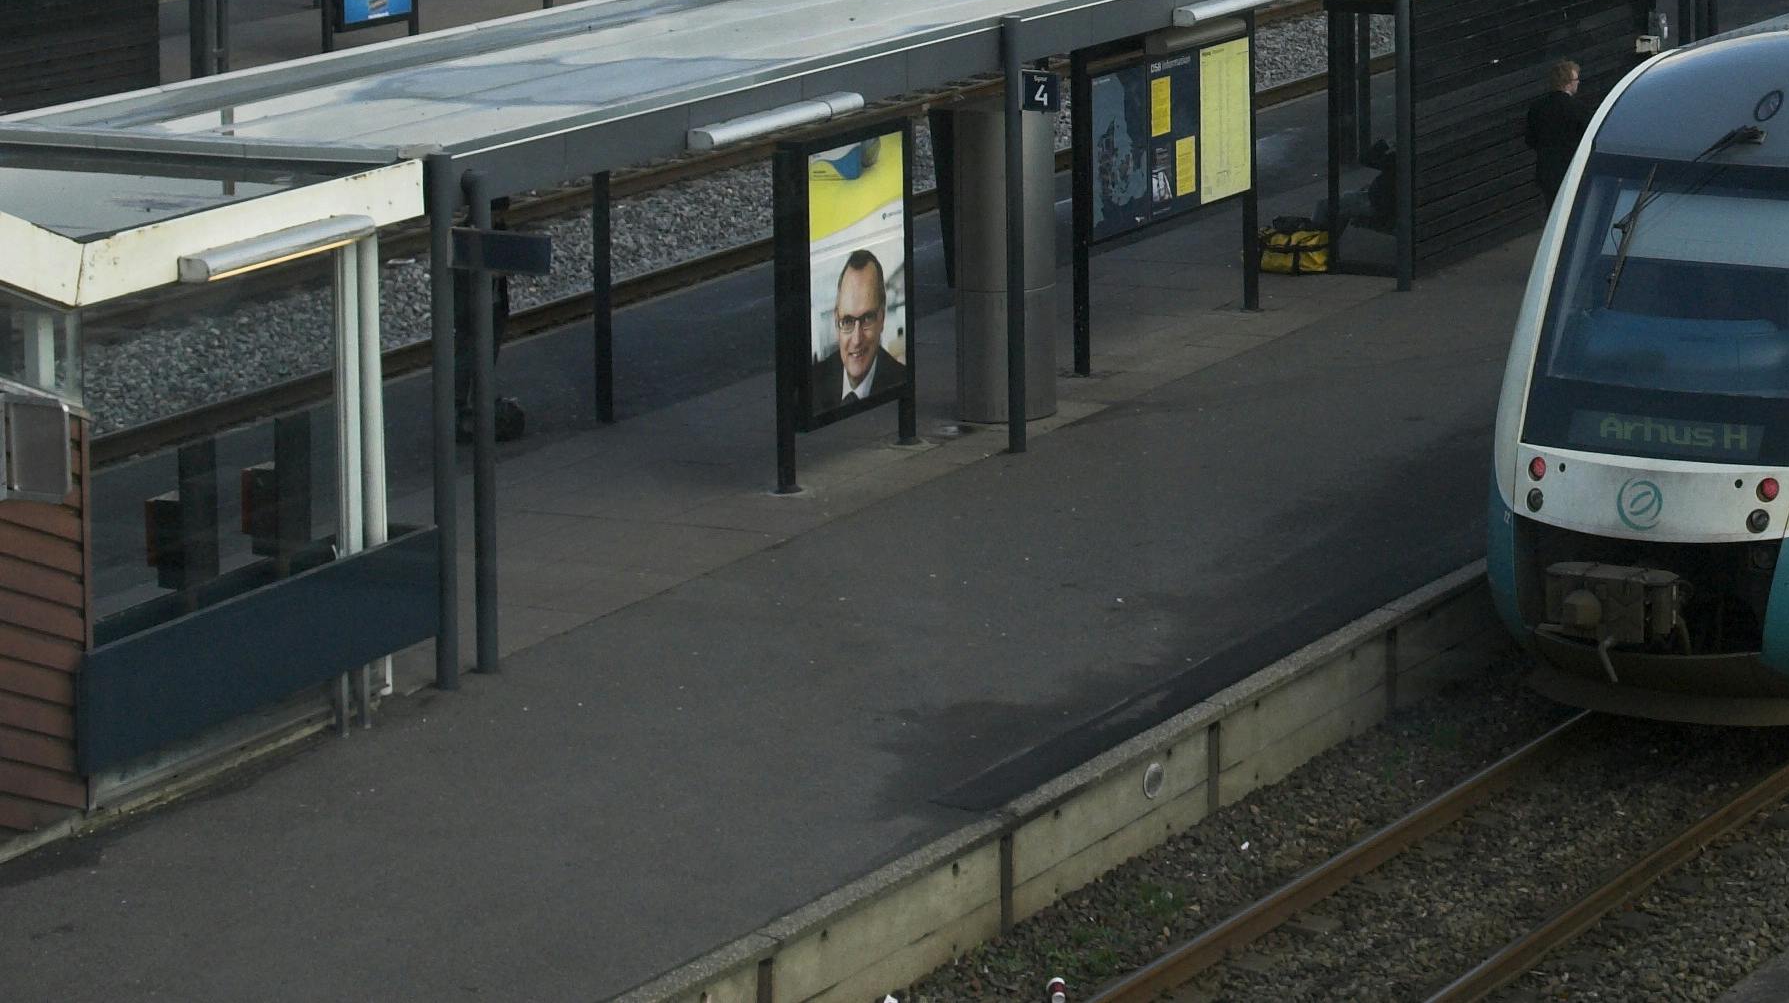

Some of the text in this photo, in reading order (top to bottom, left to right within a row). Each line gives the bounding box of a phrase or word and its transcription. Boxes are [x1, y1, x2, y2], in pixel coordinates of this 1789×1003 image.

[1034, 84, 1048, 106] 4
[1600, 412, 1748, 450] Århus H
